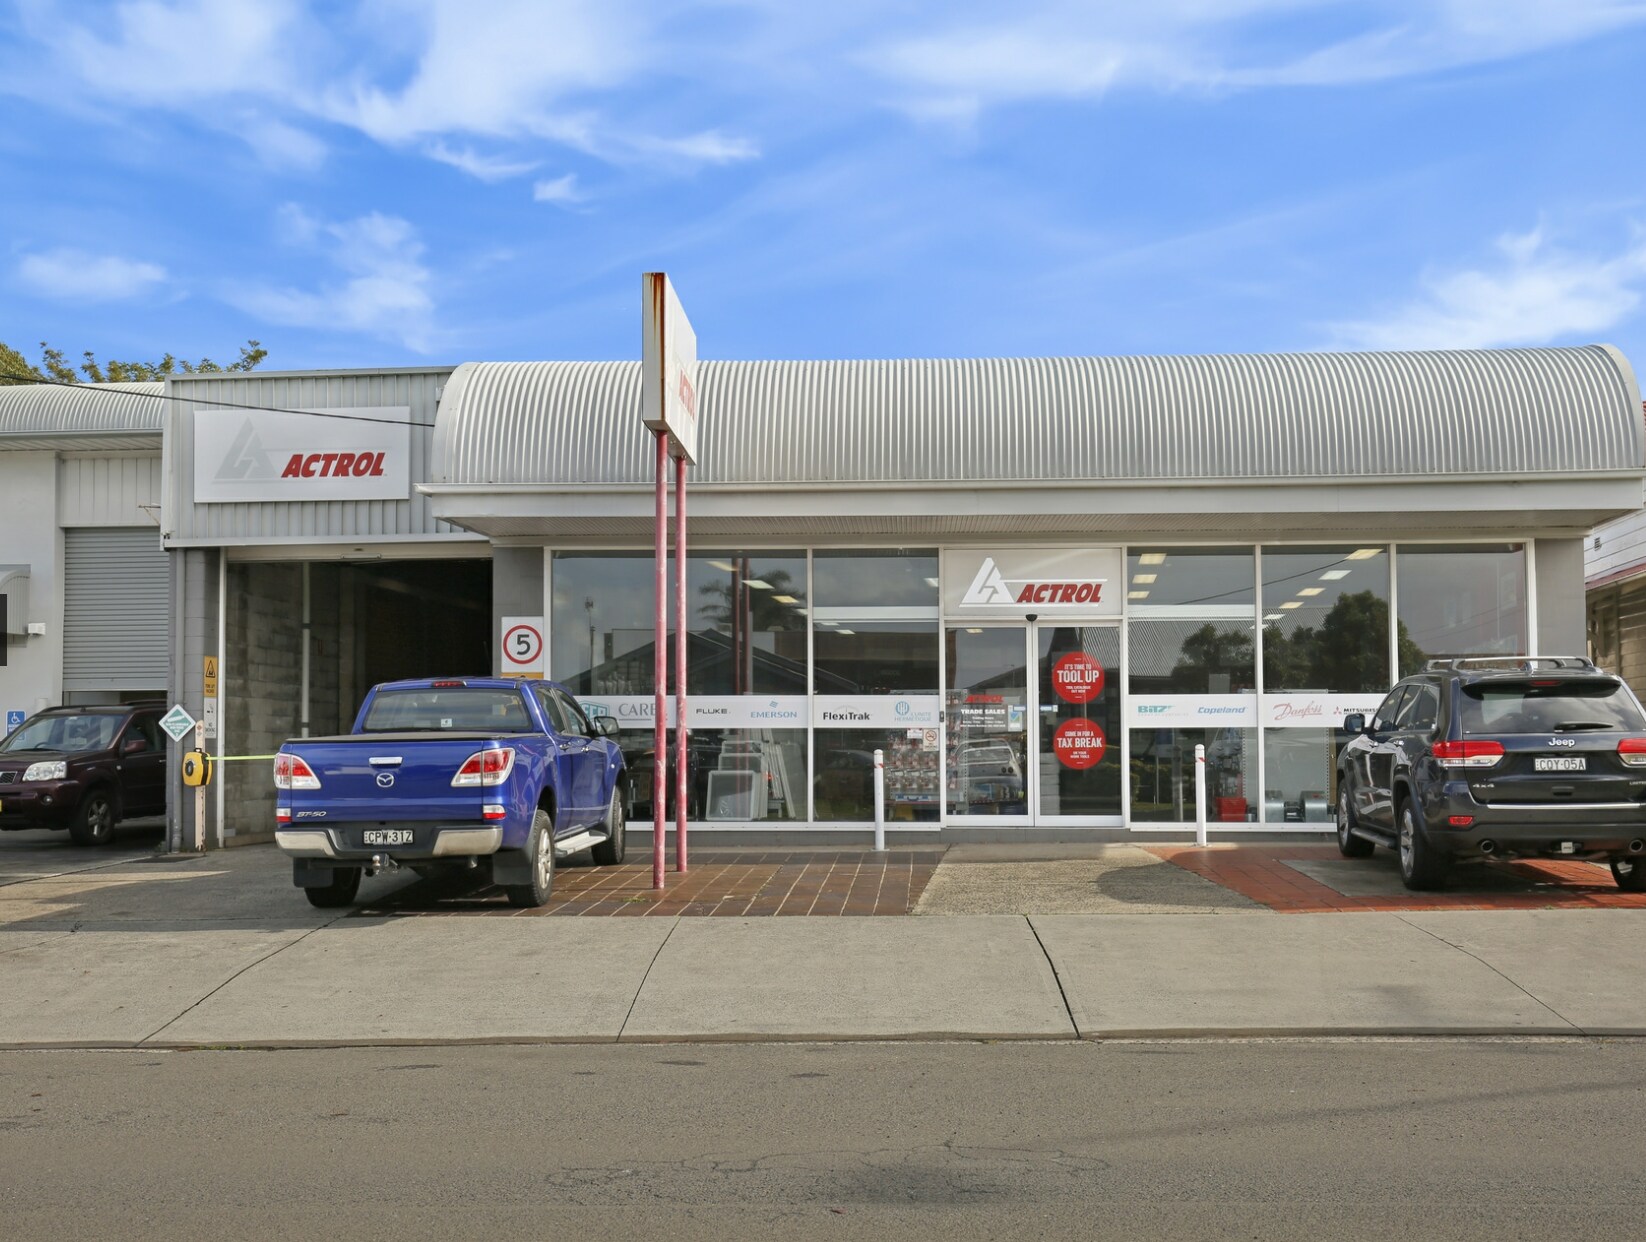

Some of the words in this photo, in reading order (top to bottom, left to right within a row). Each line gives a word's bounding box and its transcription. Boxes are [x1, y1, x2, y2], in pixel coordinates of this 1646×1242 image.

[280, 452, 385, 478] ACTROL
[1016, 583, 1102, 603] ACTROL
[516, 634, 531, 656] 5
[1057, 670, 1083, 683] TOOL
[1085, 670, 1099, 683] UP
[750, 711, 798, 719] EMERSON
[823, 711, 871, 721] FlexiTrak
[1197, 706, 1246, 715] Copeland
[1057, 737, 1073, 748] TAX
[1075, 737, 1103, 748] BREAK
[1548, 737, 1576, 748] Jeep
